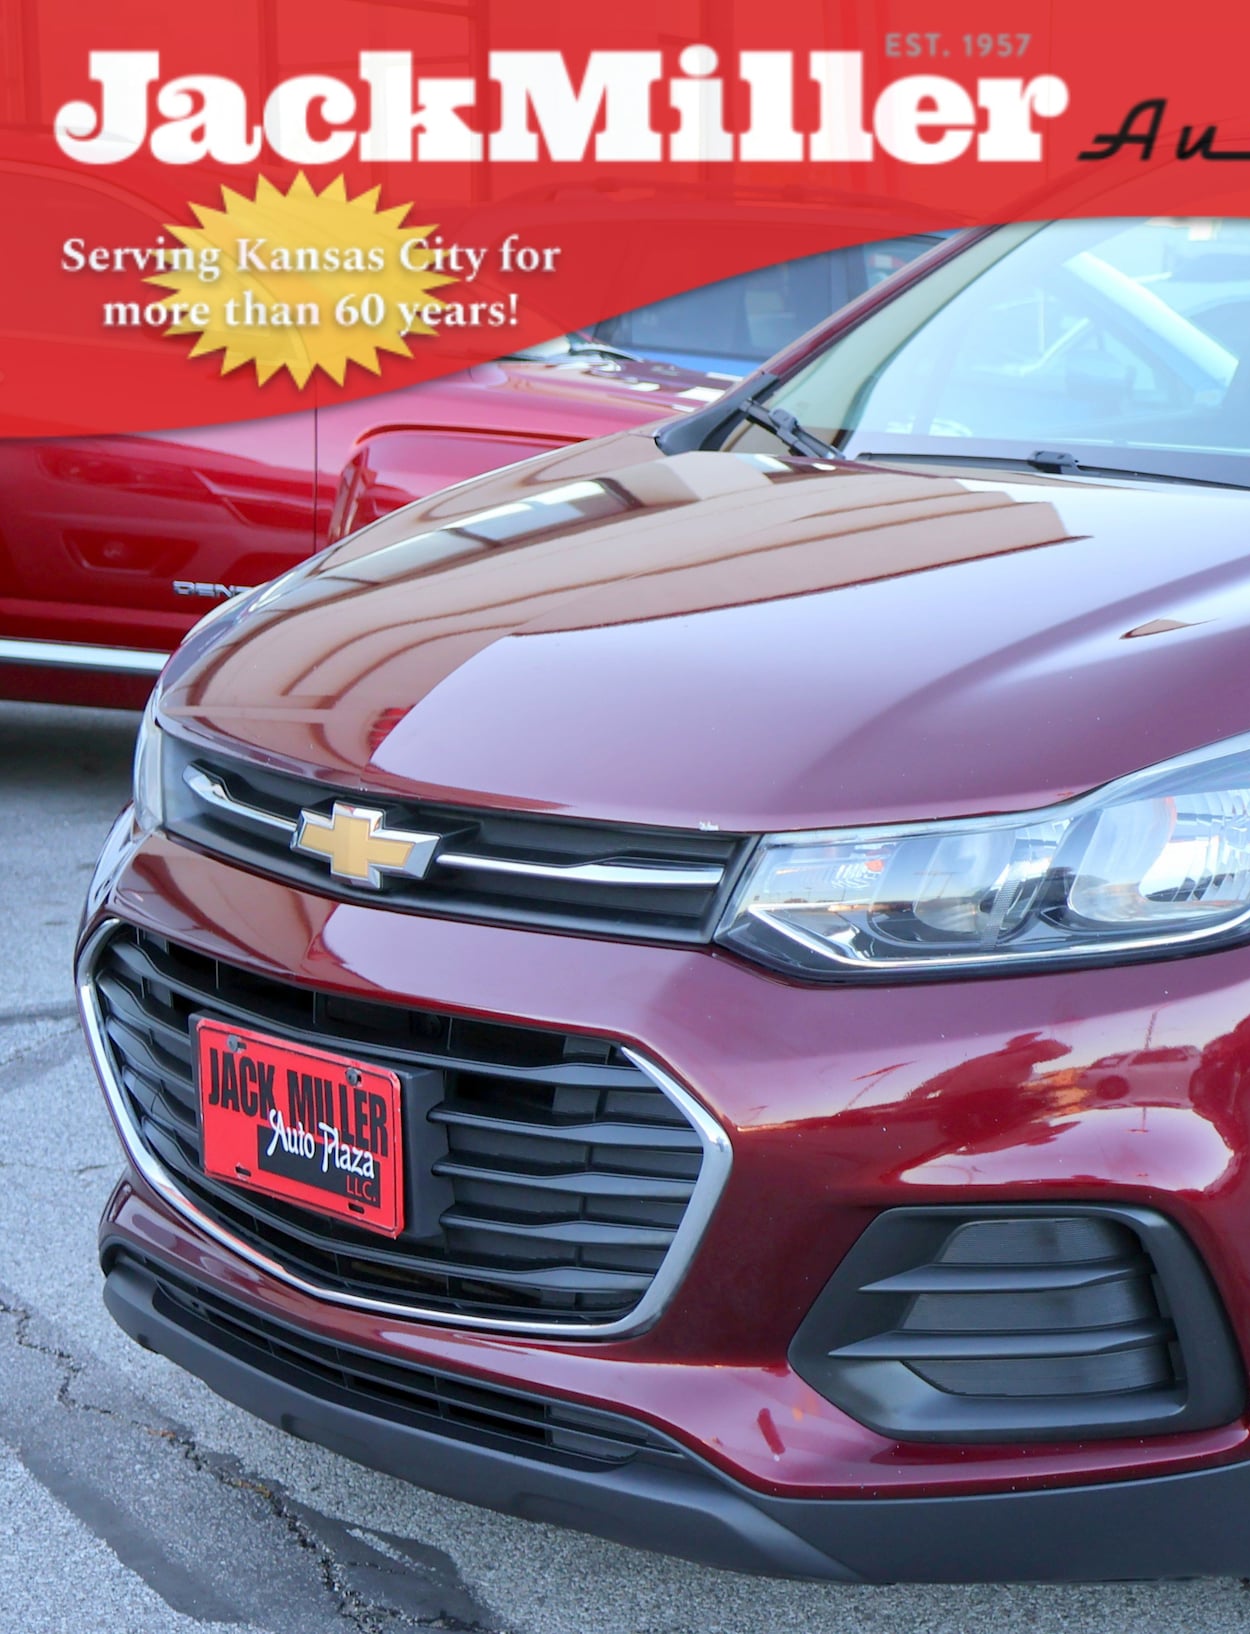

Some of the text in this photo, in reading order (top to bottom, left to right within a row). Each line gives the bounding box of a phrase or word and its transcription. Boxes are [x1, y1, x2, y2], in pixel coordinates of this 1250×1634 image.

[208, 1048, 389, 1158] JACK MILLER
[267, 1108, 375, 1180] Auto Plaza
